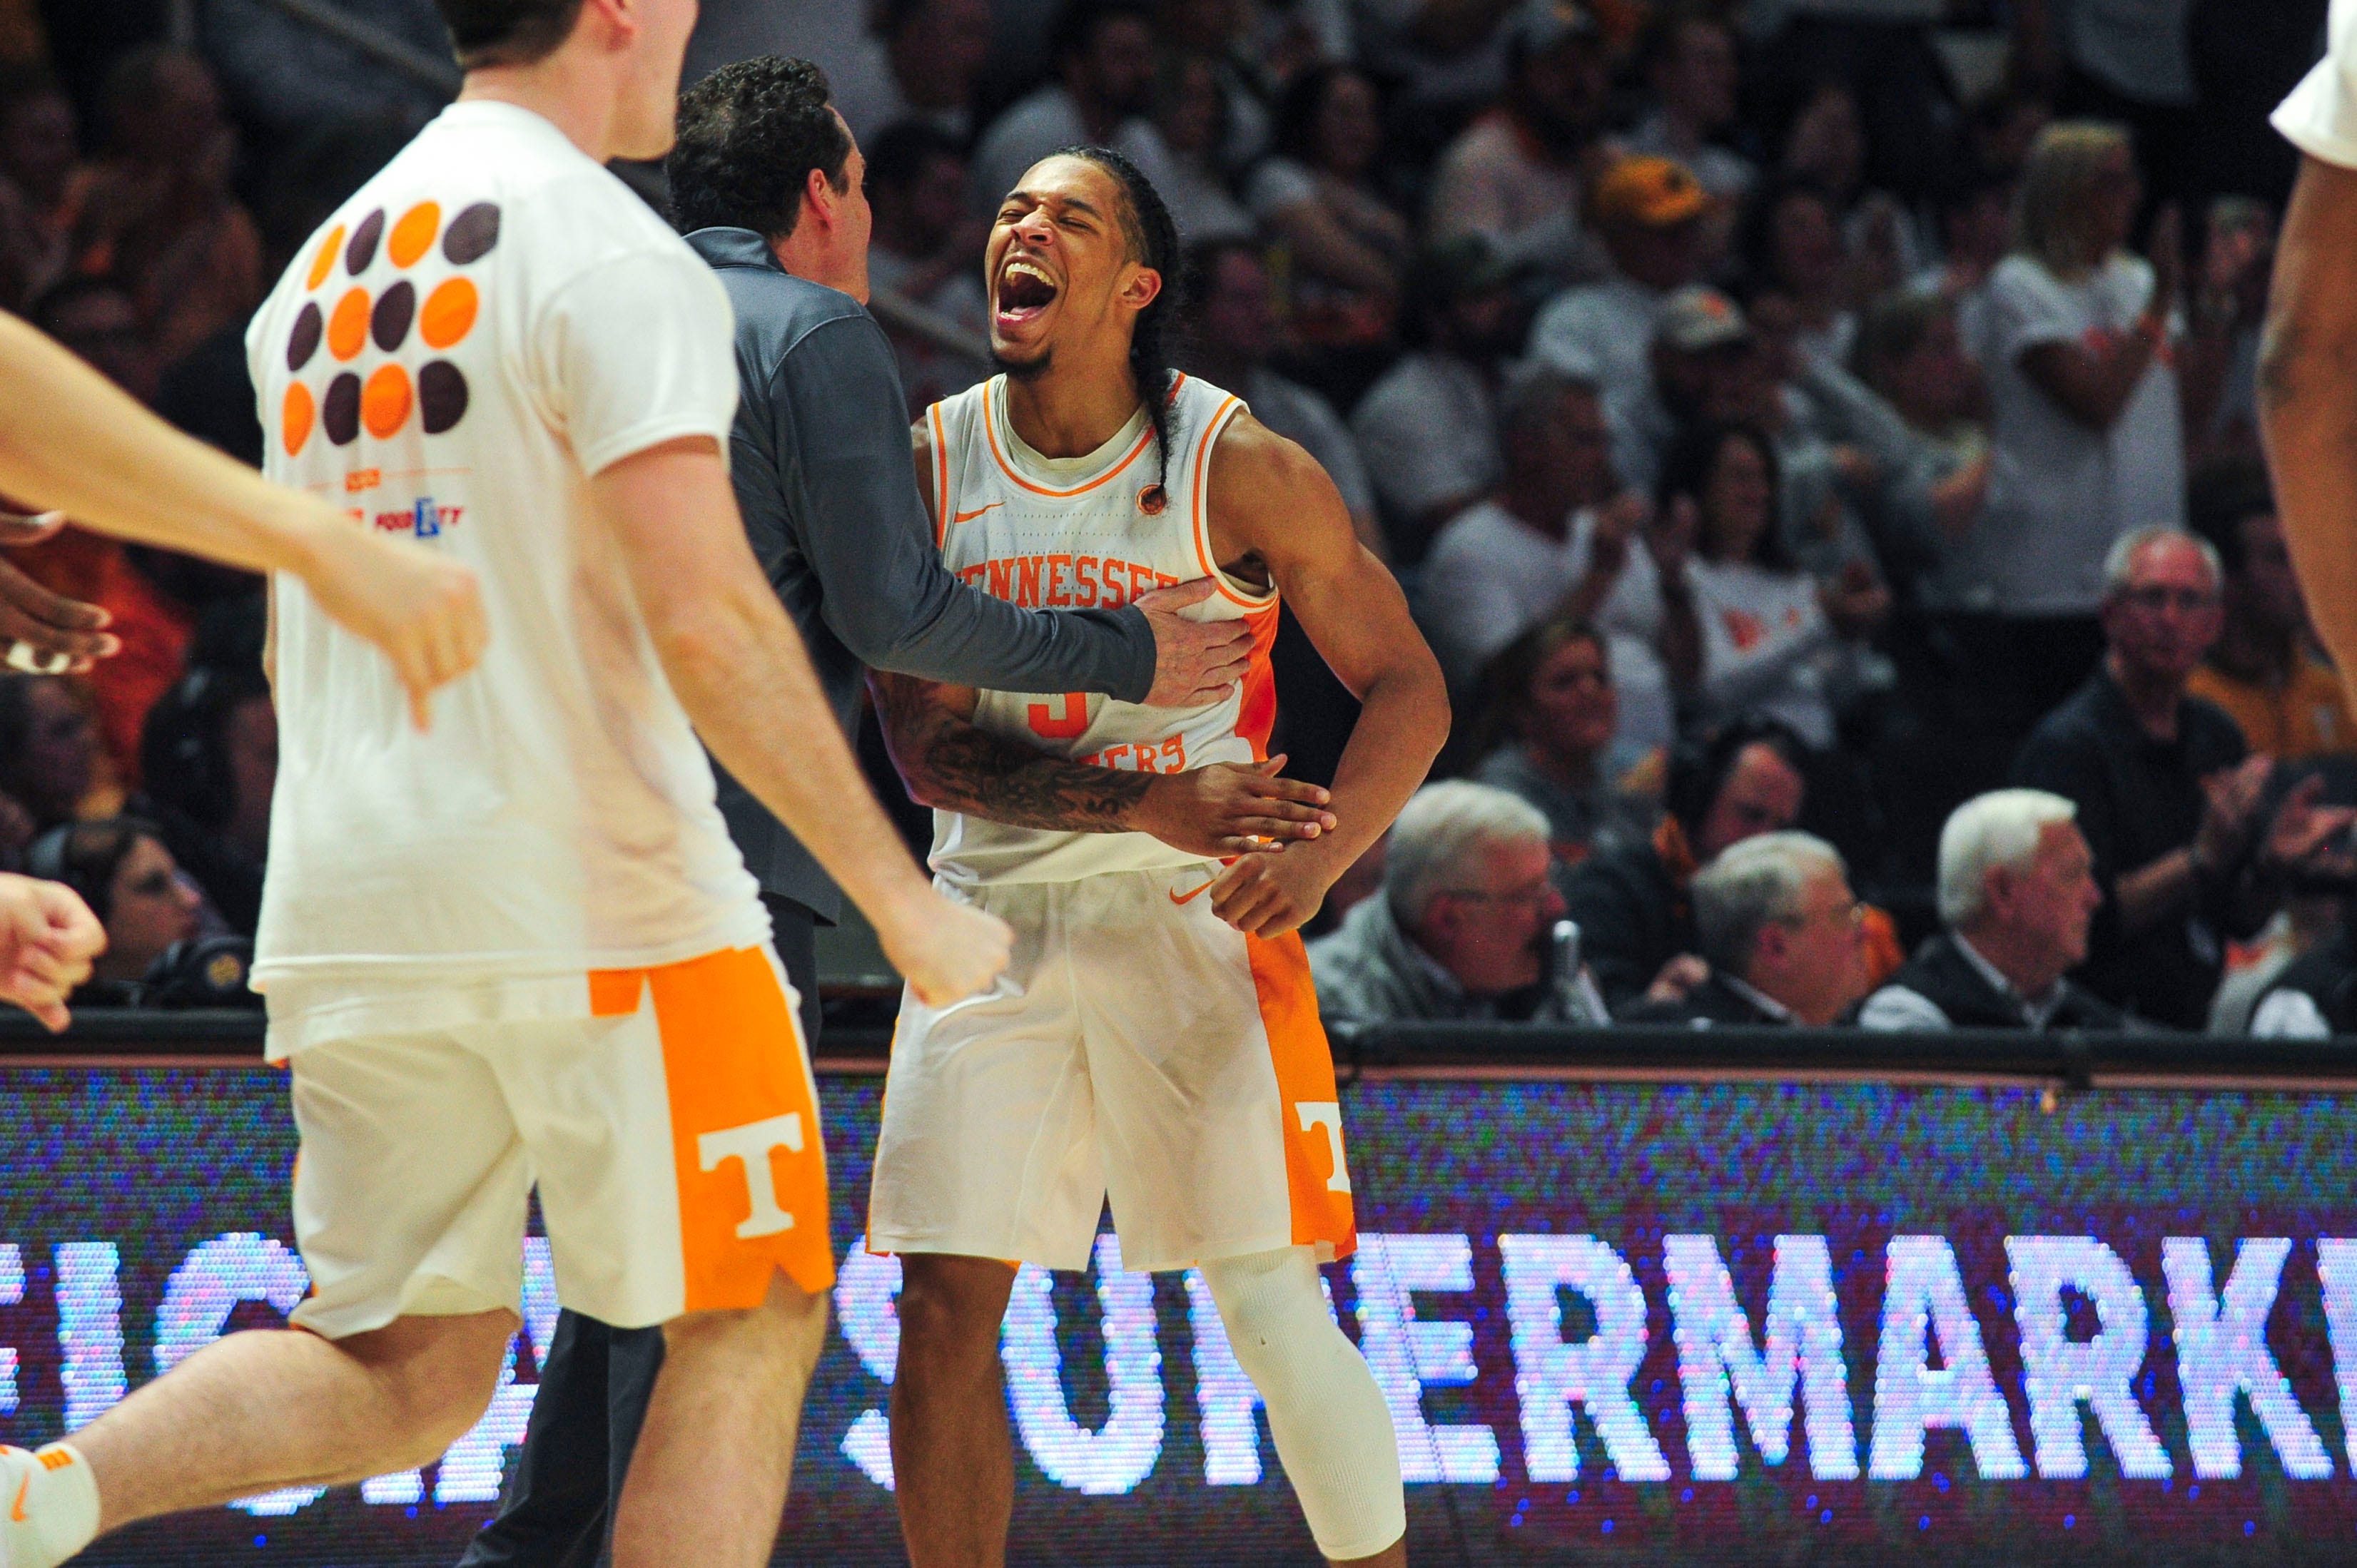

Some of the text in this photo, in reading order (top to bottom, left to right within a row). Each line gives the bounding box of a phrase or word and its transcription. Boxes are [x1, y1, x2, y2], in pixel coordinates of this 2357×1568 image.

[955, 554, 1180, 609] NNESSE
[696, 1113, 804, 1238] T
[1294, 1102, 1351, 1192] T
